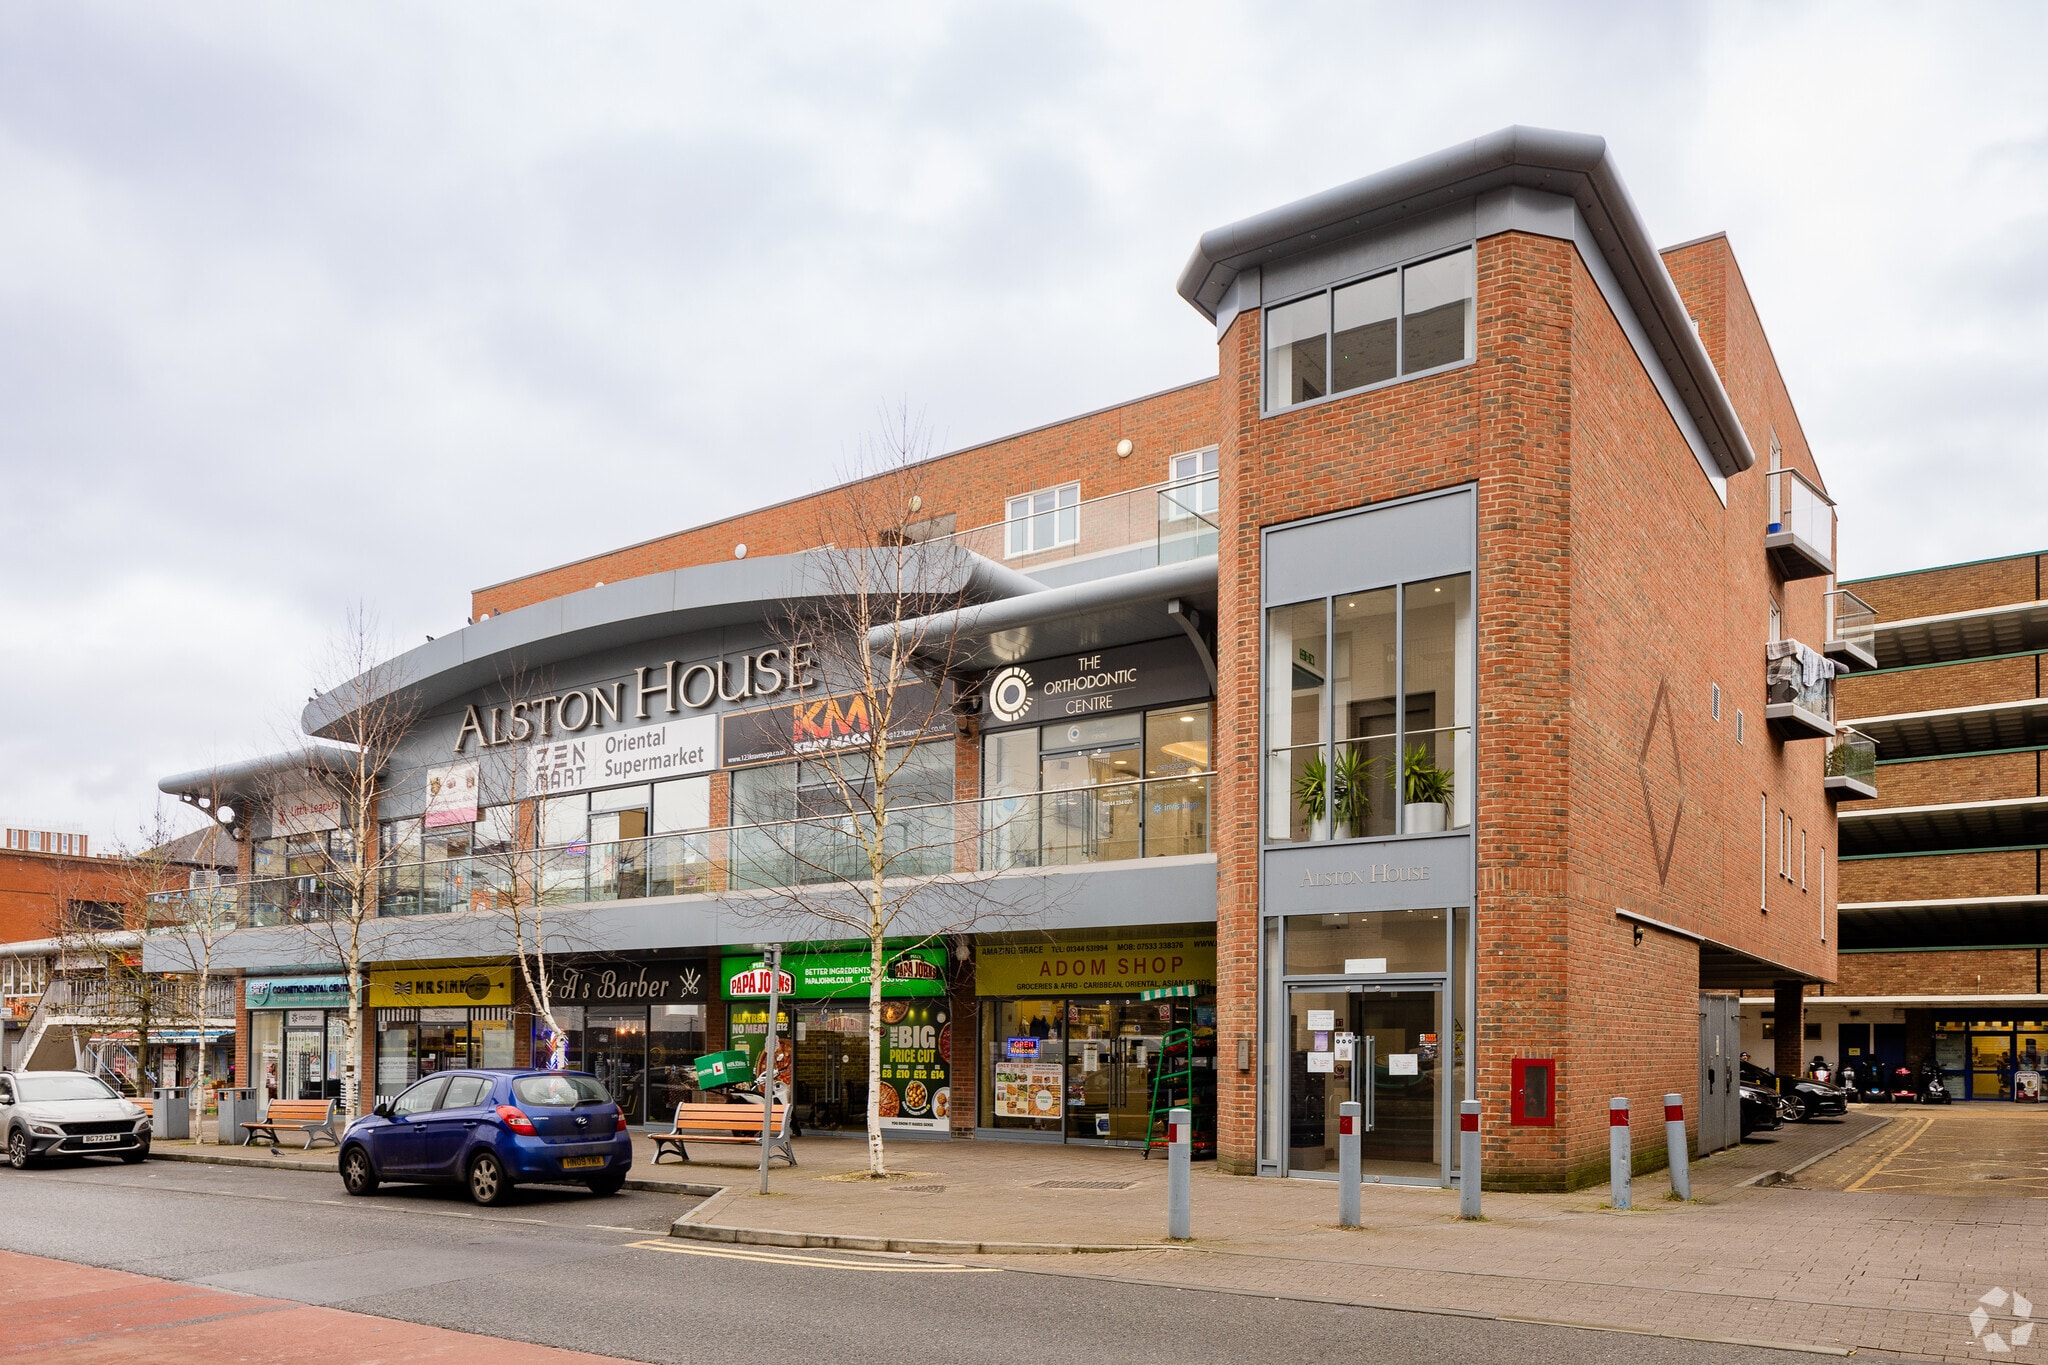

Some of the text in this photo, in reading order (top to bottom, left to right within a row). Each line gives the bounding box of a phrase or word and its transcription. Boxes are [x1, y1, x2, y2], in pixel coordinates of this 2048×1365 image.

[1078, 655, 1101, 672] THE
[1044, 668, 1137, 696] ORTHODONTIC
[454, 641, 818, 753] ALSTON HOUSE
[1065, 695, 1113, 715] CENTRE
[605, 726, 666, 755] Oriental
[829, 731, 872, 749] MAGA
[604, 746, 704, 779] Supermarket
[1299, 863, 1431, 888] ALSTON HOUSE
[981, 947, 1016, 956] AMAZING
[1018, 945, 1044, 955] GRACE
[1066, 945, 1085, 953] 01344
[1085, 944, 1109, 952] 531994
[1117, 943, 1136, 951] MOB:
[1136, 942, 1158, 950] 07533
[804, 967, 829, 976] BETTER
[1039, 956, 1184, 977] ADOM SHOP
[415, 980, 435, 995] MR
[560, 967, 670, 1000] A's Barber
[731, 971, 790, 994] PAPA JONS
[804, 976, 854, 985] PAPAJOHNS.CO.UK
[1016, 982, 1053, 990] GROCERIES
[1083, 981, 1124, 989] CARIBBEAN,
[1125, 980, 1161, 988] ORIENTAL,
[1185, 978, 1212, 987] FOODS
[272, 985, 303, 995] COSMETIC
[303, 984, 329, 994] DENTAL
[732, 1024, 768, 1034] NO MEAT
[889, 1025, 936, 1049] THE BIG
[889, 1049, 937, 1063] PRICE CUT
[715, 1065, 721, 1073] L
[882, 1069, 945, 1080] £8 £10 £12 £14
